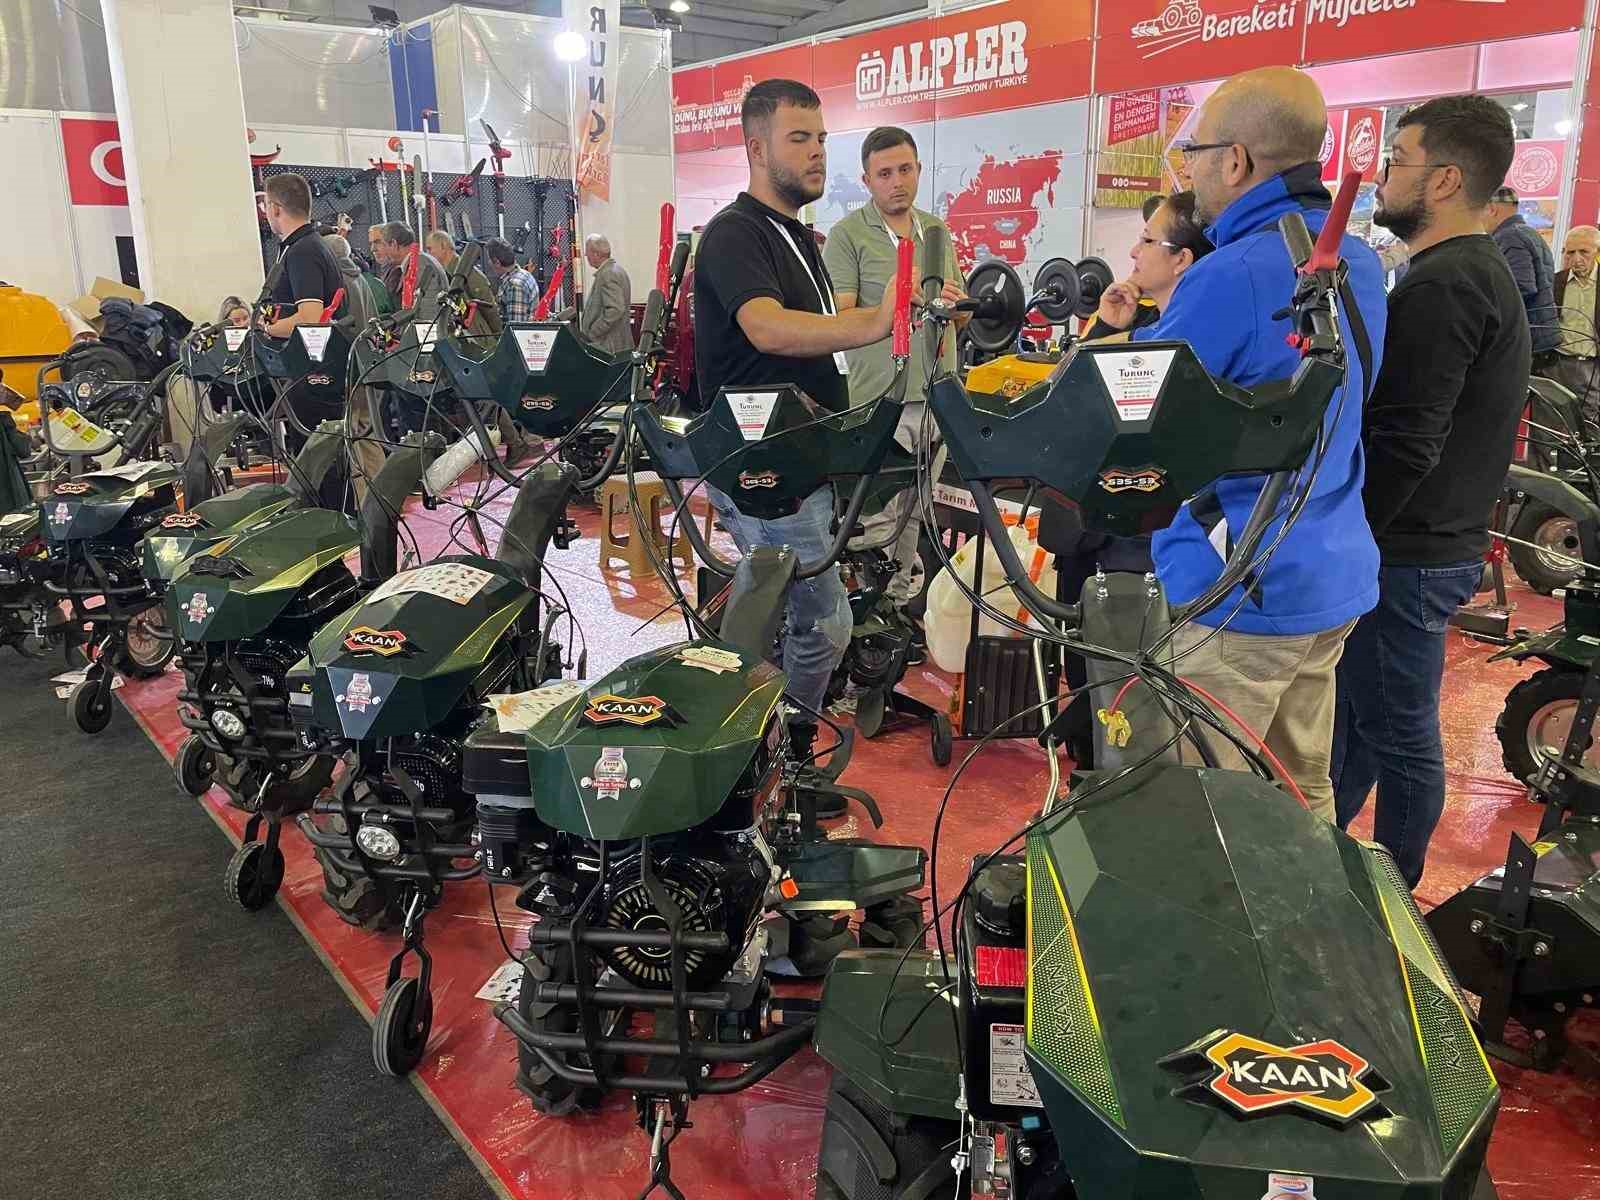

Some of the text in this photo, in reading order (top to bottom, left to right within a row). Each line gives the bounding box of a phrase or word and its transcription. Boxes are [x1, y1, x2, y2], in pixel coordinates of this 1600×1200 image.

[1202, 0, 1297, 42] Bereketi
[887, 20, 1029, 95] ALPLER
[965, 82, 989, 94] AYDIN
[986, 187, 1022, 205] RUSSIA
[999, 239, 1017, 250] CHINA
[354, 634, 397, 647] KAAN
[597, 703, 653, 714] KAAN
[1046, 963, 1074, 1039] KAAN
[1232, 1060, 1348, 1089] KAAN
